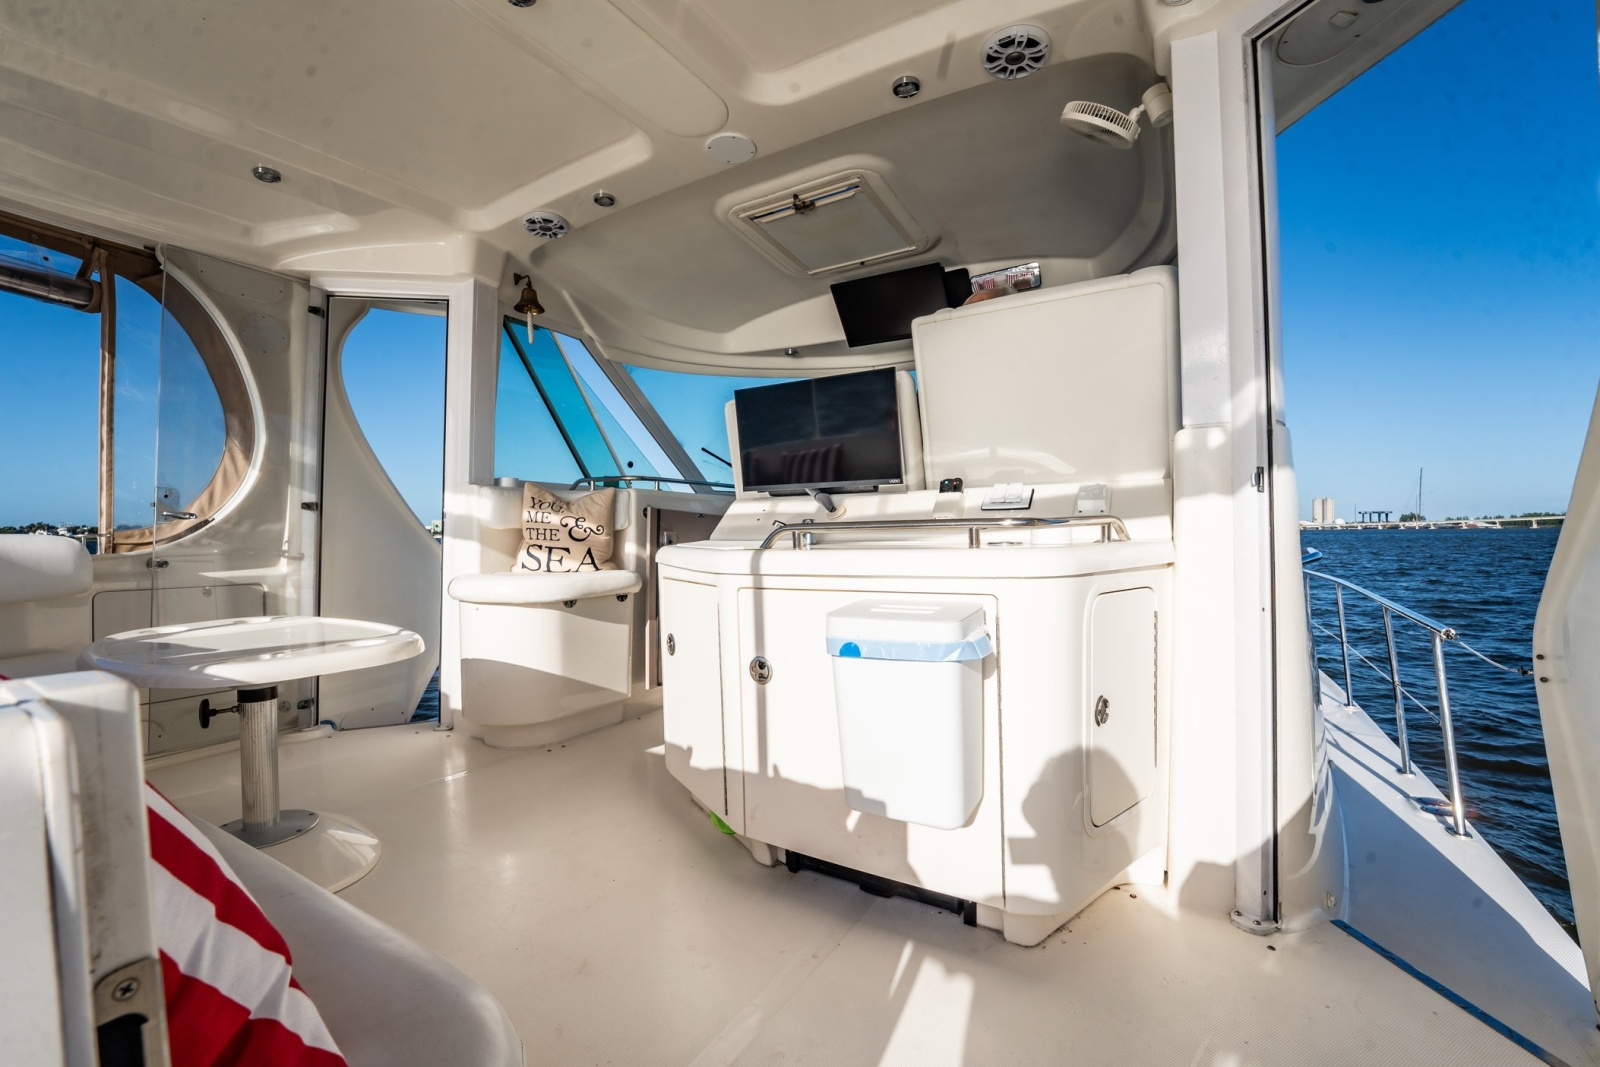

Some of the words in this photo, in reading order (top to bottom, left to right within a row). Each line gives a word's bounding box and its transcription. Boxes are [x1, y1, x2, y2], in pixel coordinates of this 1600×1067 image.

[526, 510, 552, 524] ME
[560, 515, 604, 542] &
[526, 527, 561, 541] THE
[521, 543, 603, 573] SEA
